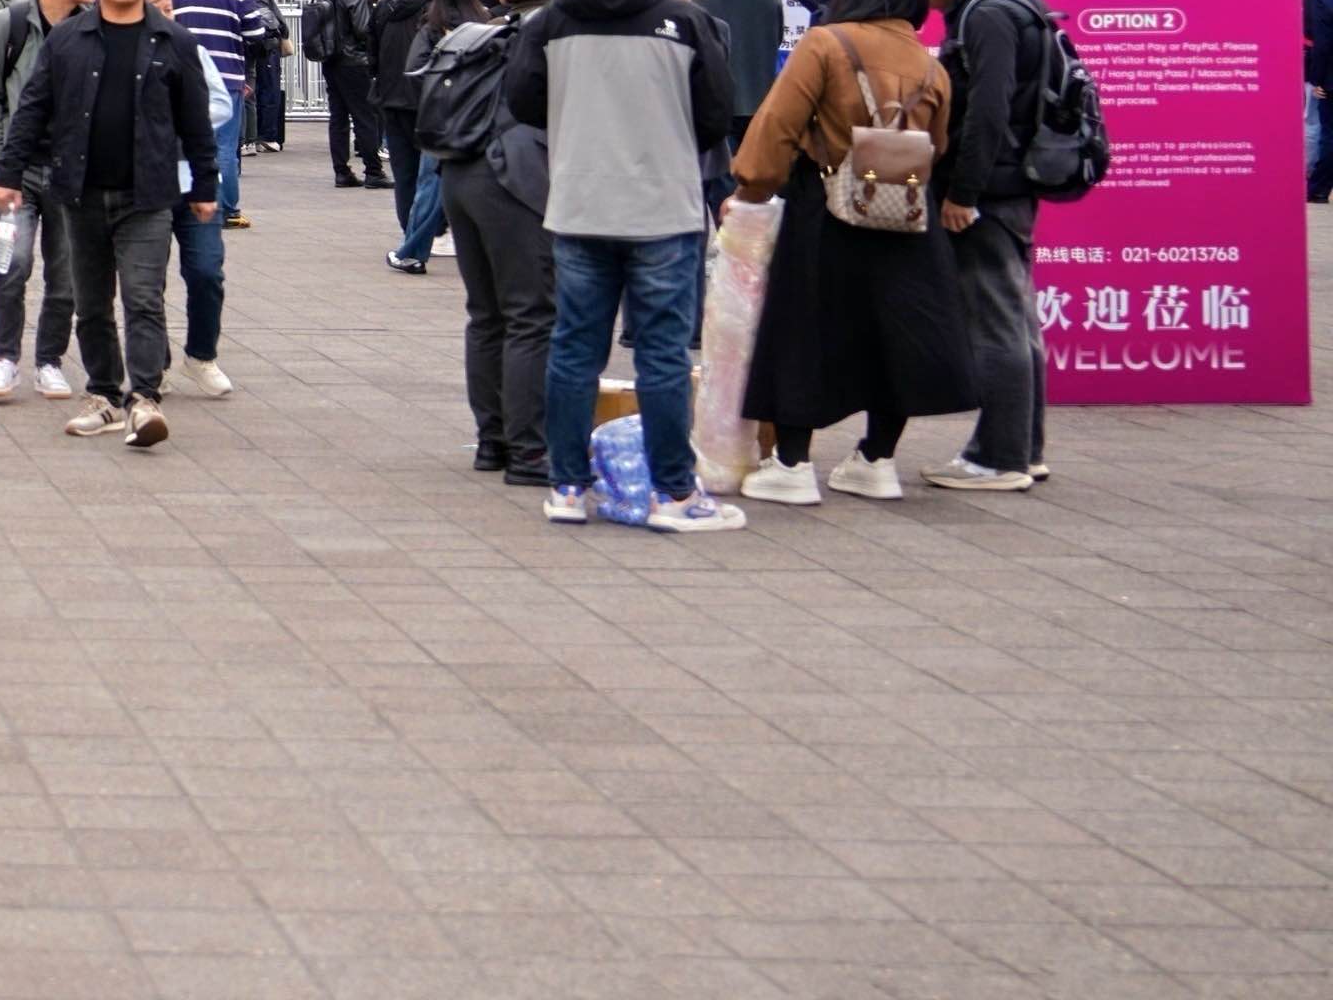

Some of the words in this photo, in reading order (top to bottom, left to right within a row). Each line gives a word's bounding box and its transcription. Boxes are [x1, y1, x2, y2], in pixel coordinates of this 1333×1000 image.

[1089, 13, 1158, 29] OPTION
[1162, 13, 1174, 28] 2
[1103, 42, 1145, 52] WeChat
[1147, 42, 1167, 53] Pay
[1222, 42, 1258, 51] Please
[1111, 56, 1145, 65] Visitor
[1147, 55, 1213, 67] Registration
[1215, 56, 1258, 66] counter
[1108, 69, 1134, 80] Hong
[1137, 69, 1163, 80] Kong
[1165, 69, 1189, 78] Pass
[1198, 69, 1232, 78] Macao
[1234, 69, 1259, 78] Pass
[1100, 83, 1134, 92] Permit
[1136, 83, 1150, 92] for
[1154, 82, 1190, 92] Taiwan
[1247, 83, 1259, 91] to
[1117, 97, 1158, 107] process.
[1138, 141, 1161, 152] only
[1178, 141, 1253, 152] professionals.
[1151, 154, 1170, 162] and
[1115, 167, 1132, 175] are
[1136, 166, 1153, 175] not
[1156, 166, 1208, 177] permitted
[1117, 179, 1132, 187] not
[1122, 246, 1240, 262] 021-60213768
[1035, 285, 1251, 331] 欢迎莅临
